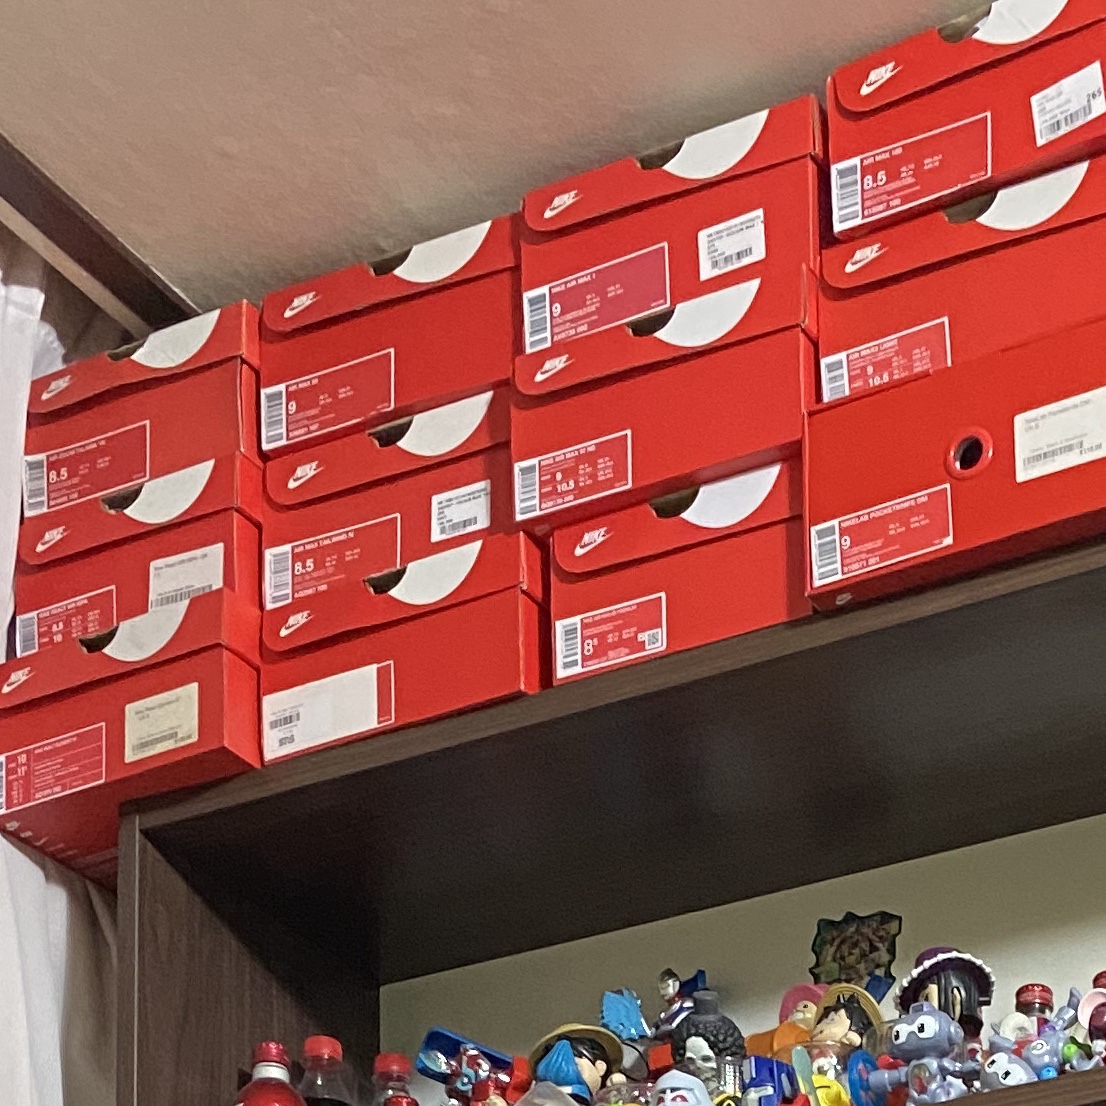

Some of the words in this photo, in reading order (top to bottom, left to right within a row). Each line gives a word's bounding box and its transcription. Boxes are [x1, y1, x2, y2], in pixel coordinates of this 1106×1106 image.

[551, 301, 560, 318] 9
[287, 400, 296, 415] 9
[840, 534, 850, 550] 9
[294, 557, 313, 575] 8.5
